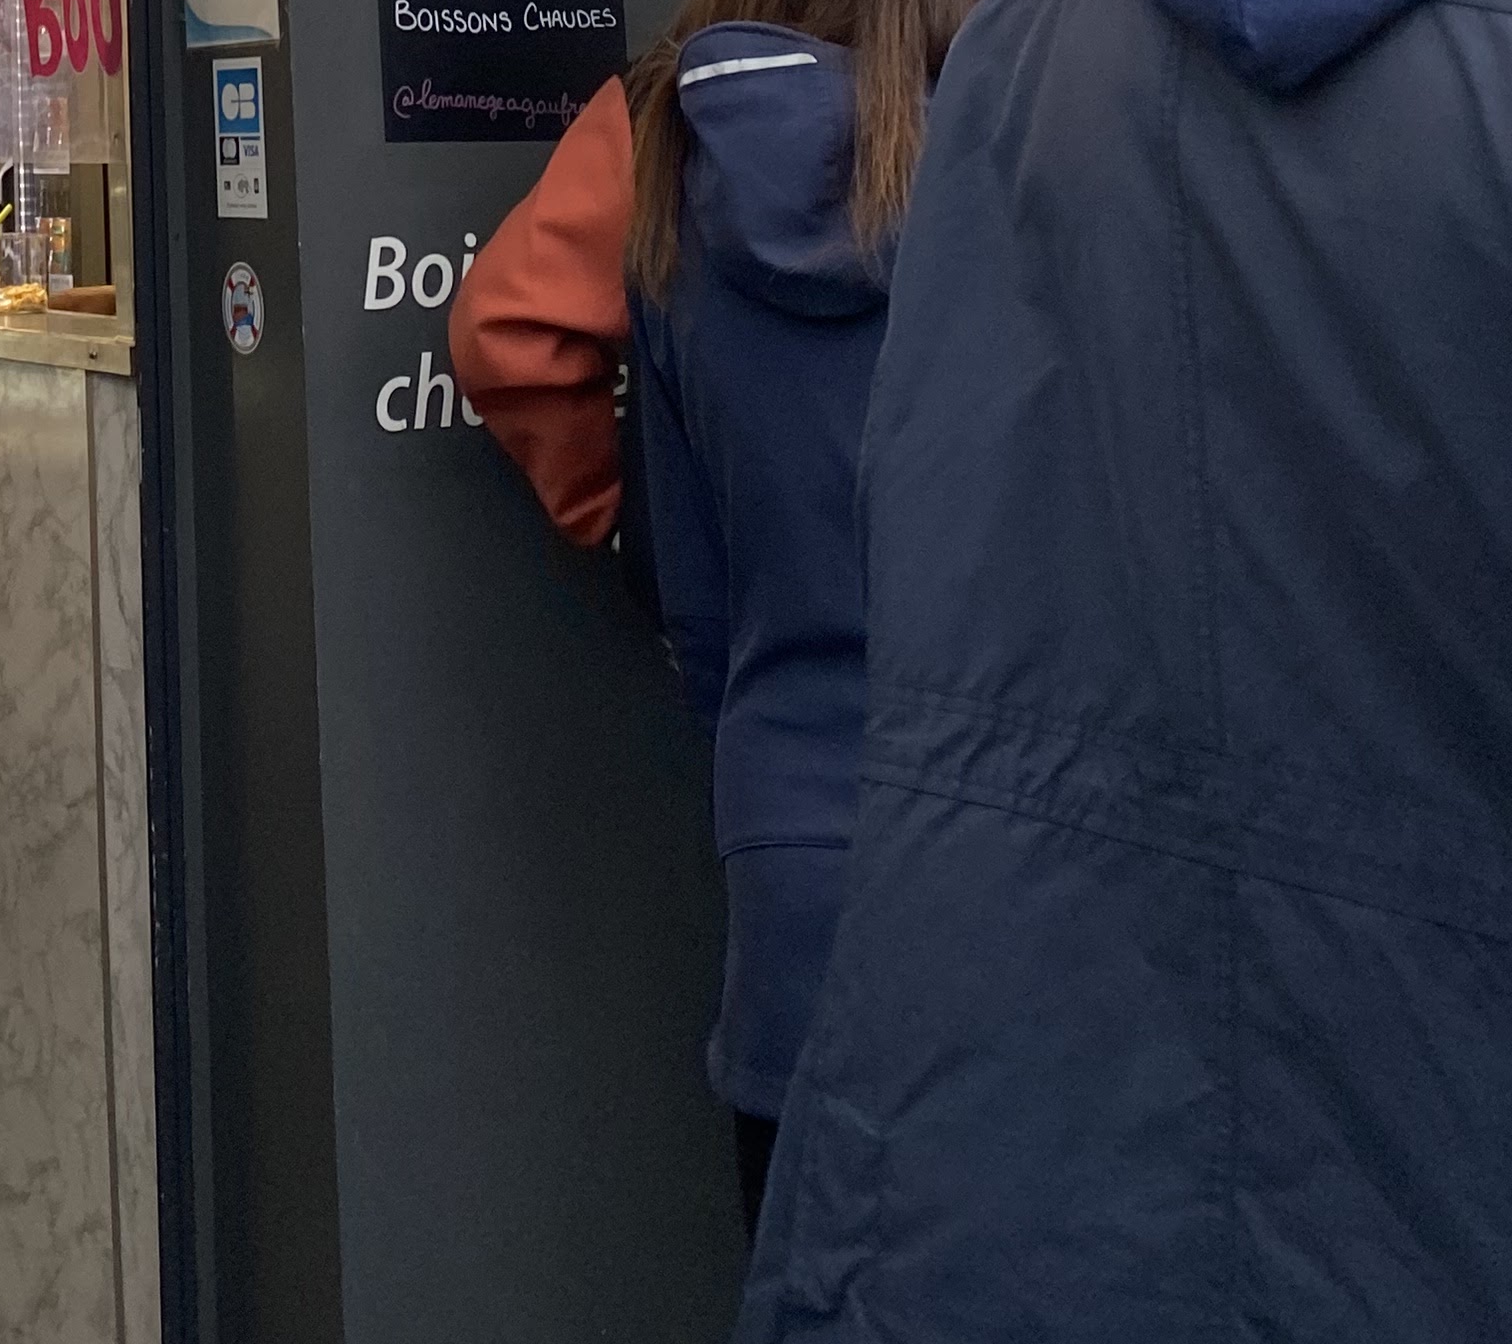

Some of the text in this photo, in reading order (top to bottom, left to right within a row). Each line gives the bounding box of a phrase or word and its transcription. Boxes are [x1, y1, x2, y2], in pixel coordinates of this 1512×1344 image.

[394, 0, 617, 34] BOISSONS CHAUDES
[243, 144, 260, 157] VISA
